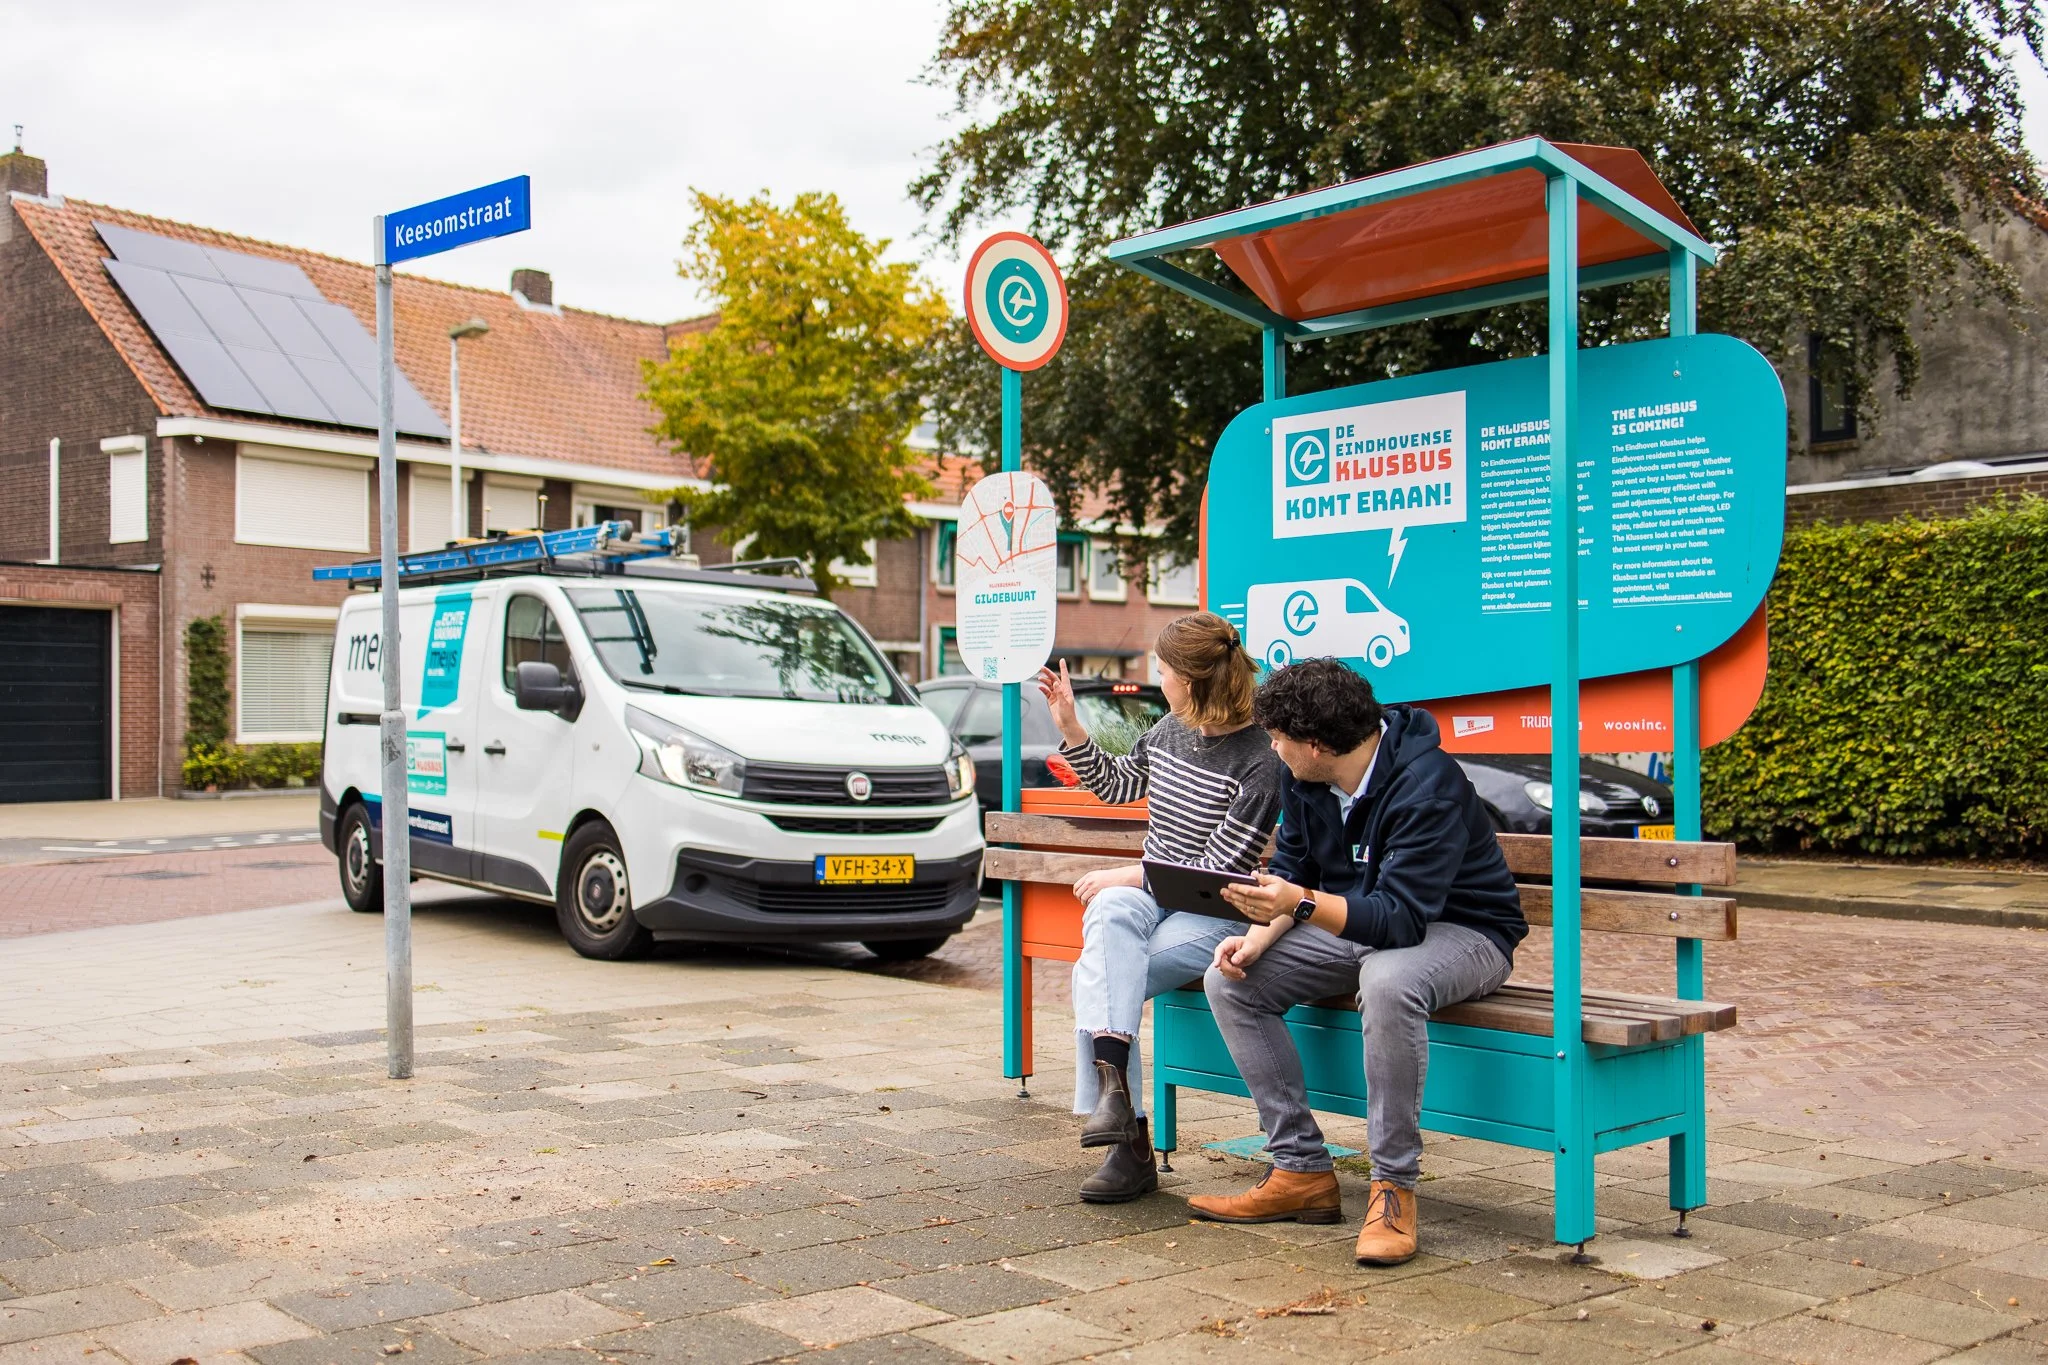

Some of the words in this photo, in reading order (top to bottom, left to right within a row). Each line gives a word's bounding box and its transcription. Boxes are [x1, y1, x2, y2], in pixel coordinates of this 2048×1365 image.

[395, 196, 512, 248] Keesomstraat
[1612, 408, 1636, 421] THE
[1638, 400, 1697, 418] KLUSBUS
[1336, 424, 1355, 440] DE
[1481, 426, 1495, 437] DE
[1498, 420, 1550, 435] KLUSBUS
[1612, 424, 1626, 435] IS
[1629, 417, 1684, 433] COMING!
[1336, 429, 1452, 457] EINDHOVENSE
[1481, 439, 1512, 451] KOMT
[1625, 442, 1658, 451] Eindhoven
[1660, 439, 1686, 447] Klusbus
[1490, 458, 1526, 466] Eindhovense
[1612, 455, 1645, 464] Eindhoven
[1646, 451, 1676, 460] residents
[1336, 448, 1452, 482] KLUSBUS
[1612, 464, 1659, 475] neighborhoods
[1703, 457, 1731, 465] Whether
[1481, 469, 1523, 478] Eindhovenaren
[1612, 478, 1625, 487] you
[1672, 483, 1700, 492] efficient
[1500, 489, 1535, 497] koopwoning
[1286, 493, 1351, 521] KOMT
[1357, 482, 1452, 514] ERAAN!
[1677, 507, 1688, 516] get
[1502, 520, 1537, 530] bijvoorbeeld
[1513, 530, 1549, 538] radiatorfolie
[1642, 560, 1680, 568] information
[1676, 569, 1706, 577] schedule
[974, 590, 1037, 604] GILDEBUURT
[1482, 592, 1507, 600] afspraak
[870, 733, 927, 747] meijs
[832, 859, 906, 876] VFH-34-X
